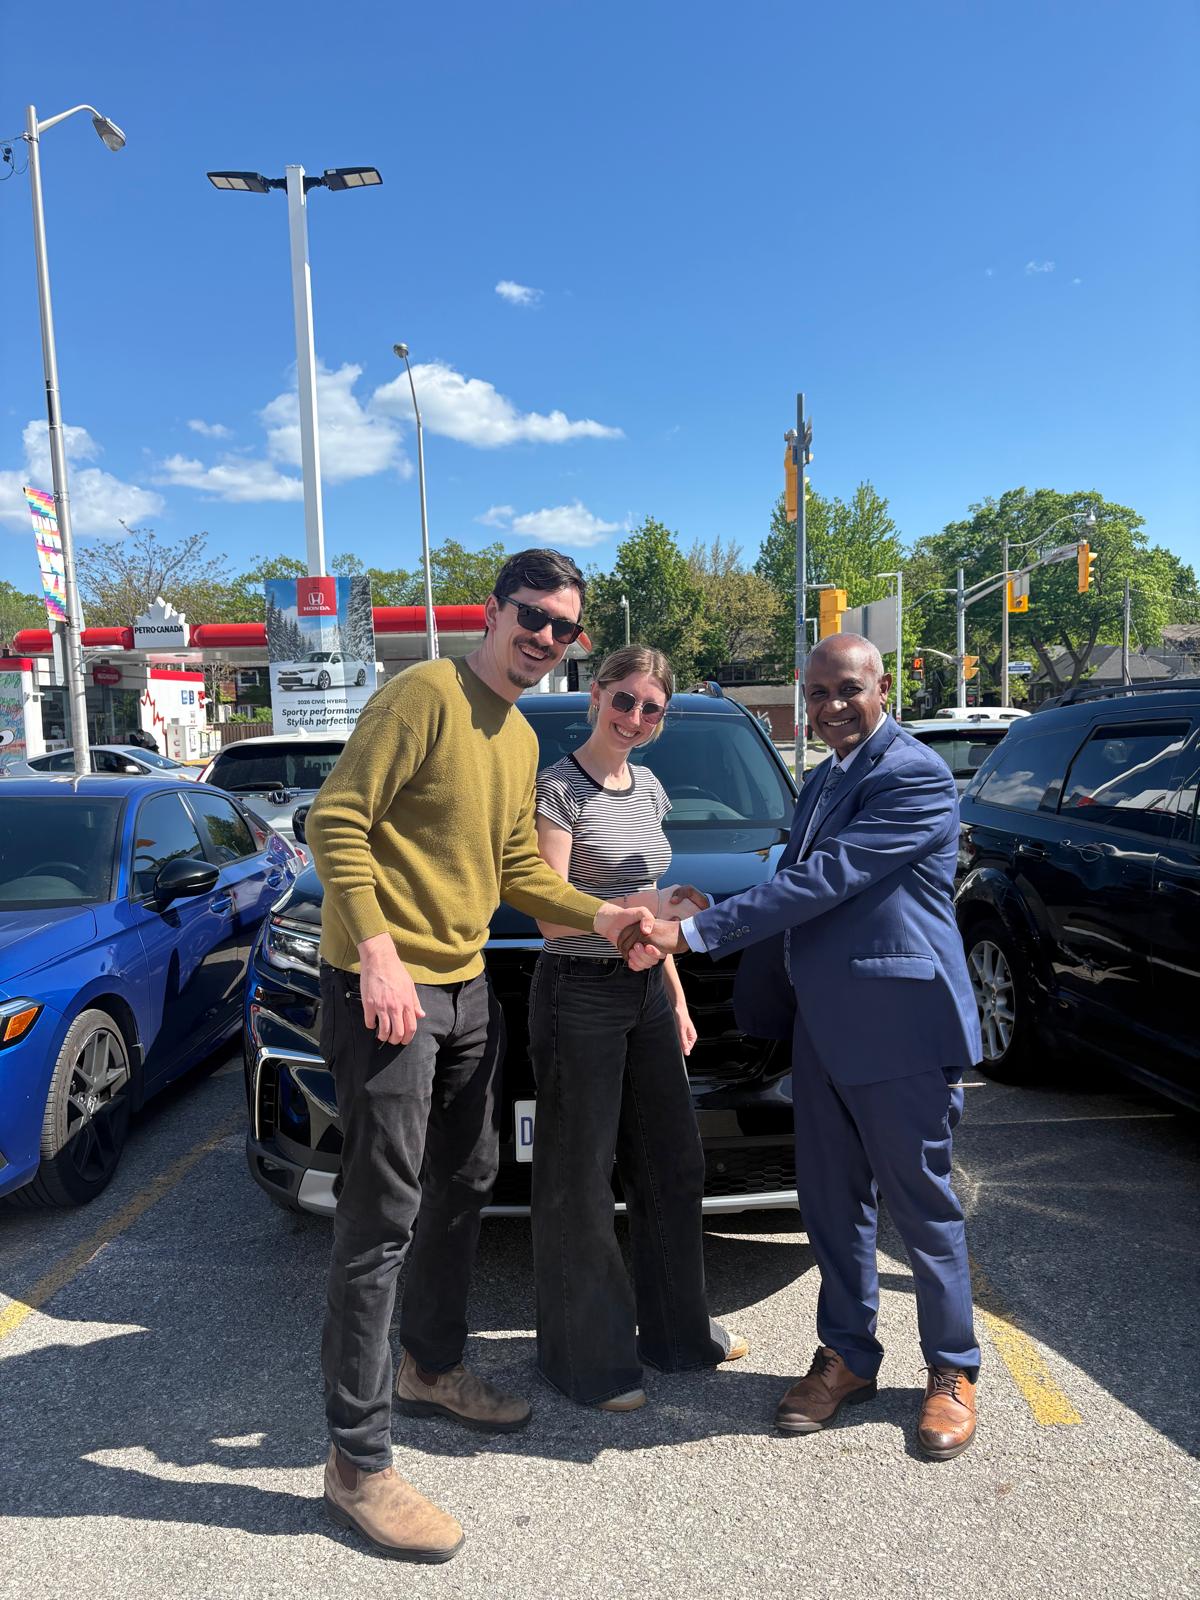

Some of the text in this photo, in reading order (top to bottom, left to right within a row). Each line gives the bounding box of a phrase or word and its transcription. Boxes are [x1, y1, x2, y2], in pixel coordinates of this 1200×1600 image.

[281, 708, 310, 717] Sporty
[286, 717, 314, 728] Stylish
[520, 1116, 535, 1146] D
